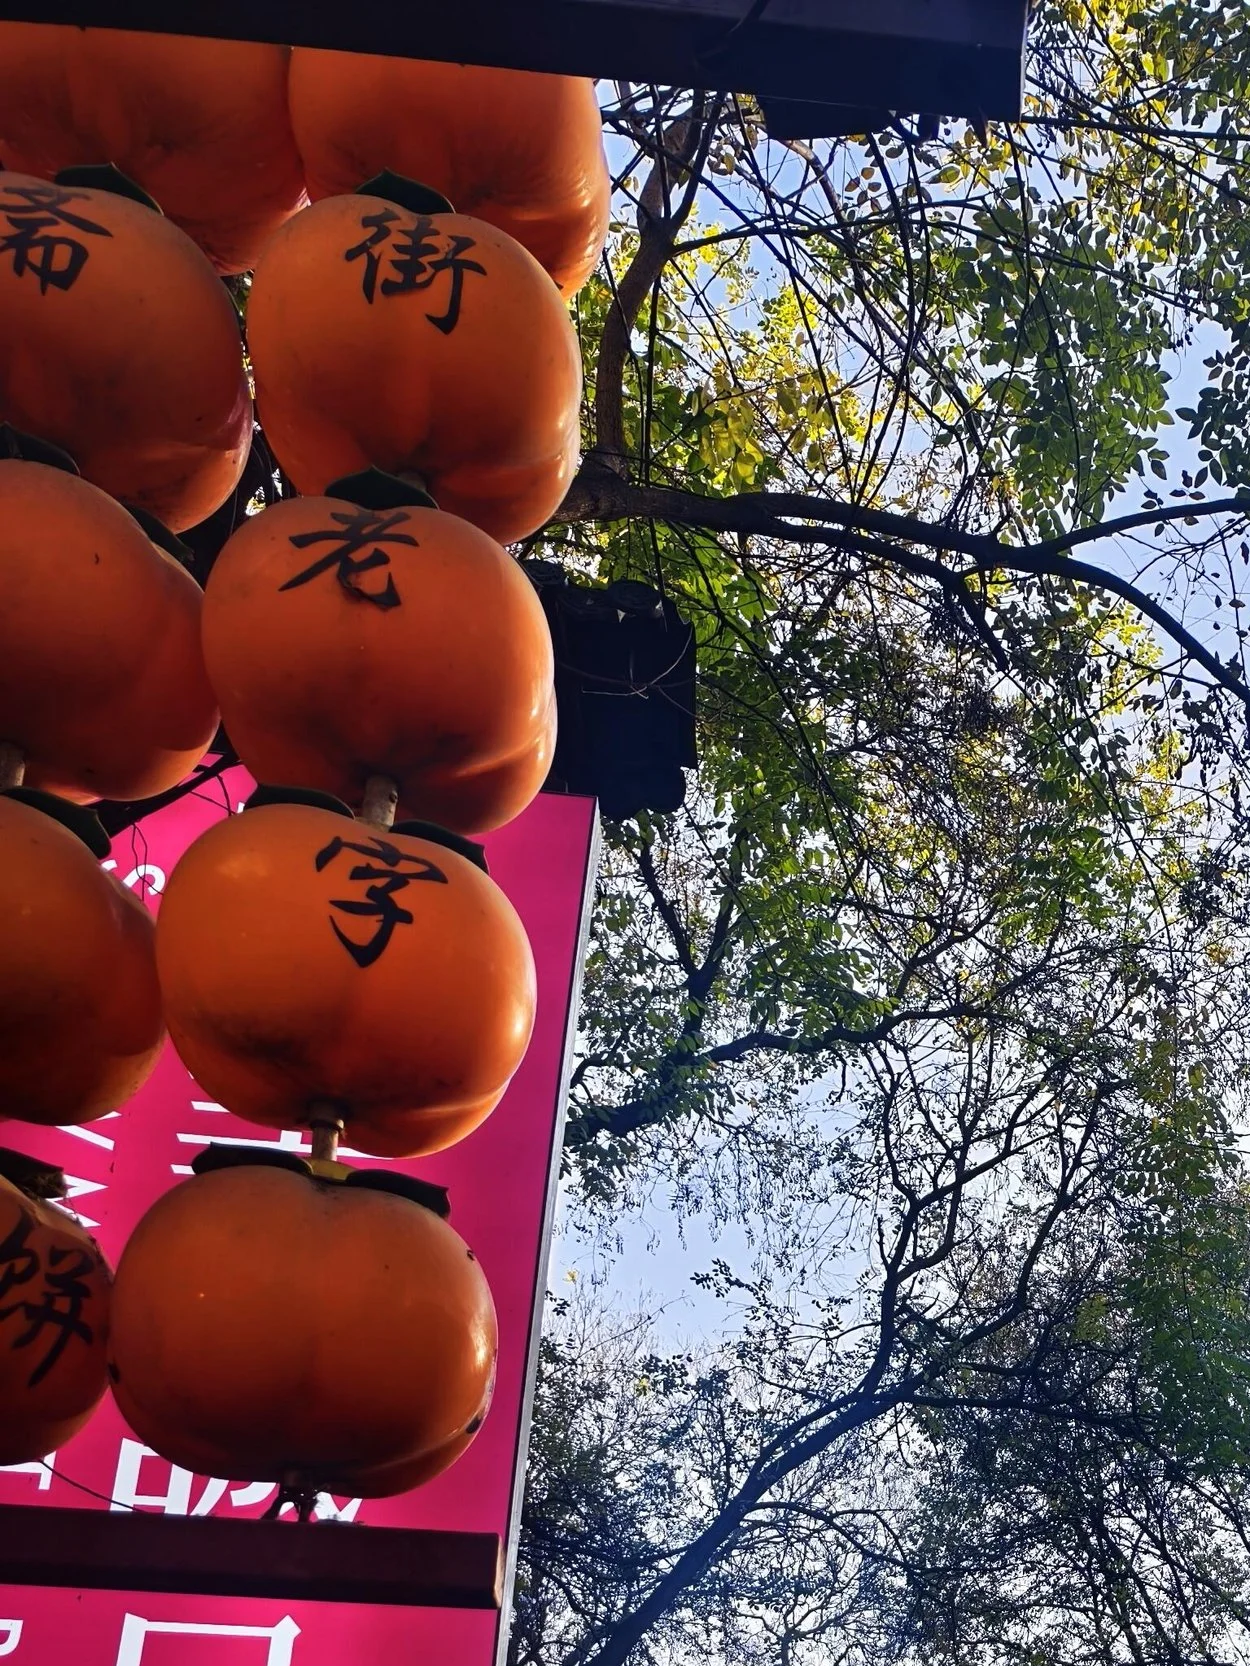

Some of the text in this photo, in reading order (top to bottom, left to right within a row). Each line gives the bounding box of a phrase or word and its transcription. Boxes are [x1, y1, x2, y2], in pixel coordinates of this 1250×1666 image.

[345, 205, 487, 335] 街
[279, 511, 419, 607] 老
[315, 834, 448, 967] 字
